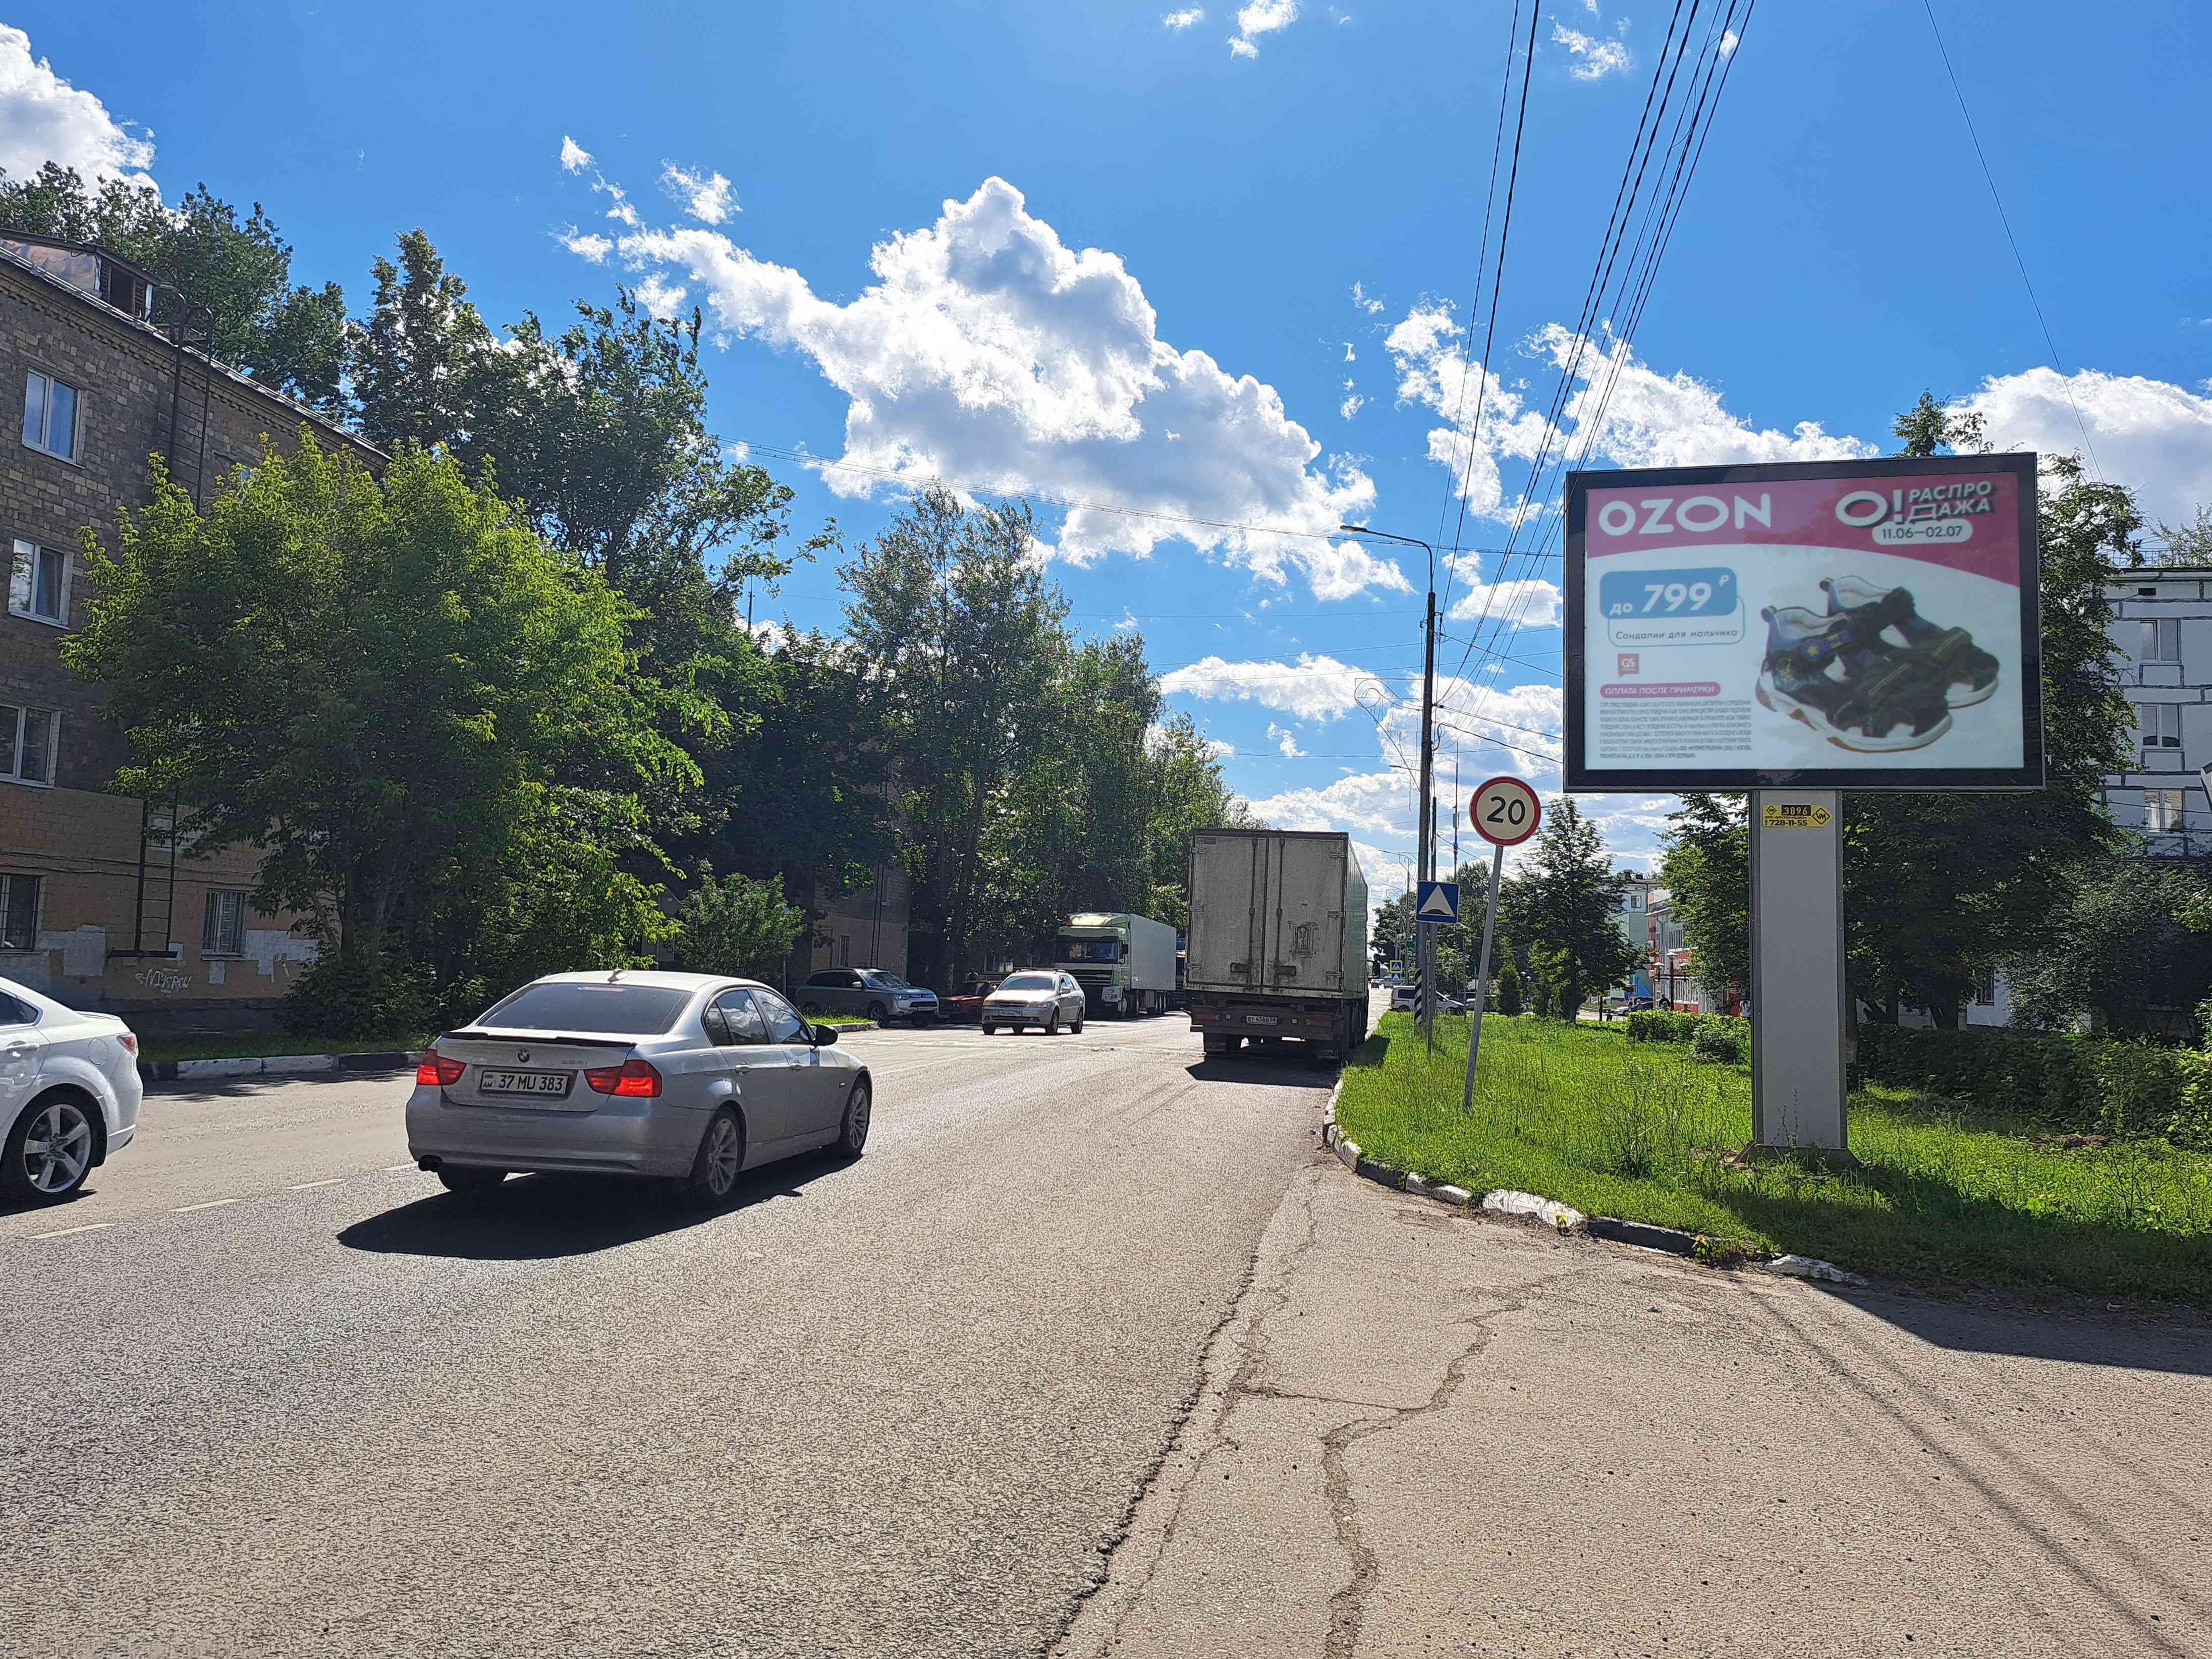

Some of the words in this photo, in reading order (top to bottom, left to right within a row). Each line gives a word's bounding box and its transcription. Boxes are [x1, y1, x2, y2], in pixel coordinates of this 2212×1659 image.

[1909, 481, 1992, 503] РАСПРО
[1598, 493, 1771, 536] OZON
[1907, 497, 1990, 522] ДАЖА
[1609, 602, 1633, 616] до
[1641, 582, 1712, 613] 799
[1615, 631, 1665, 640] Сандалии
[1668, 631, 1686, 639] для
[1690, 629, 1738, 638] мальчика
[1621, 657, 1636, 668] GS
[1605, 687, 1637, 695] ОПЛАТА
[1639, 686, 1668, 695] ПОСЛЕ
[1669, 685, 1715, 694] ПРИМЕРКИ
[1486, 796, 1526, 825] 20
[1783, 806, 1808, 815] 3896
[497, 1074, 515, 1089] 37
[517, 1075, 537, 1090] MU
[539, 1076, 564, 1091] 383
